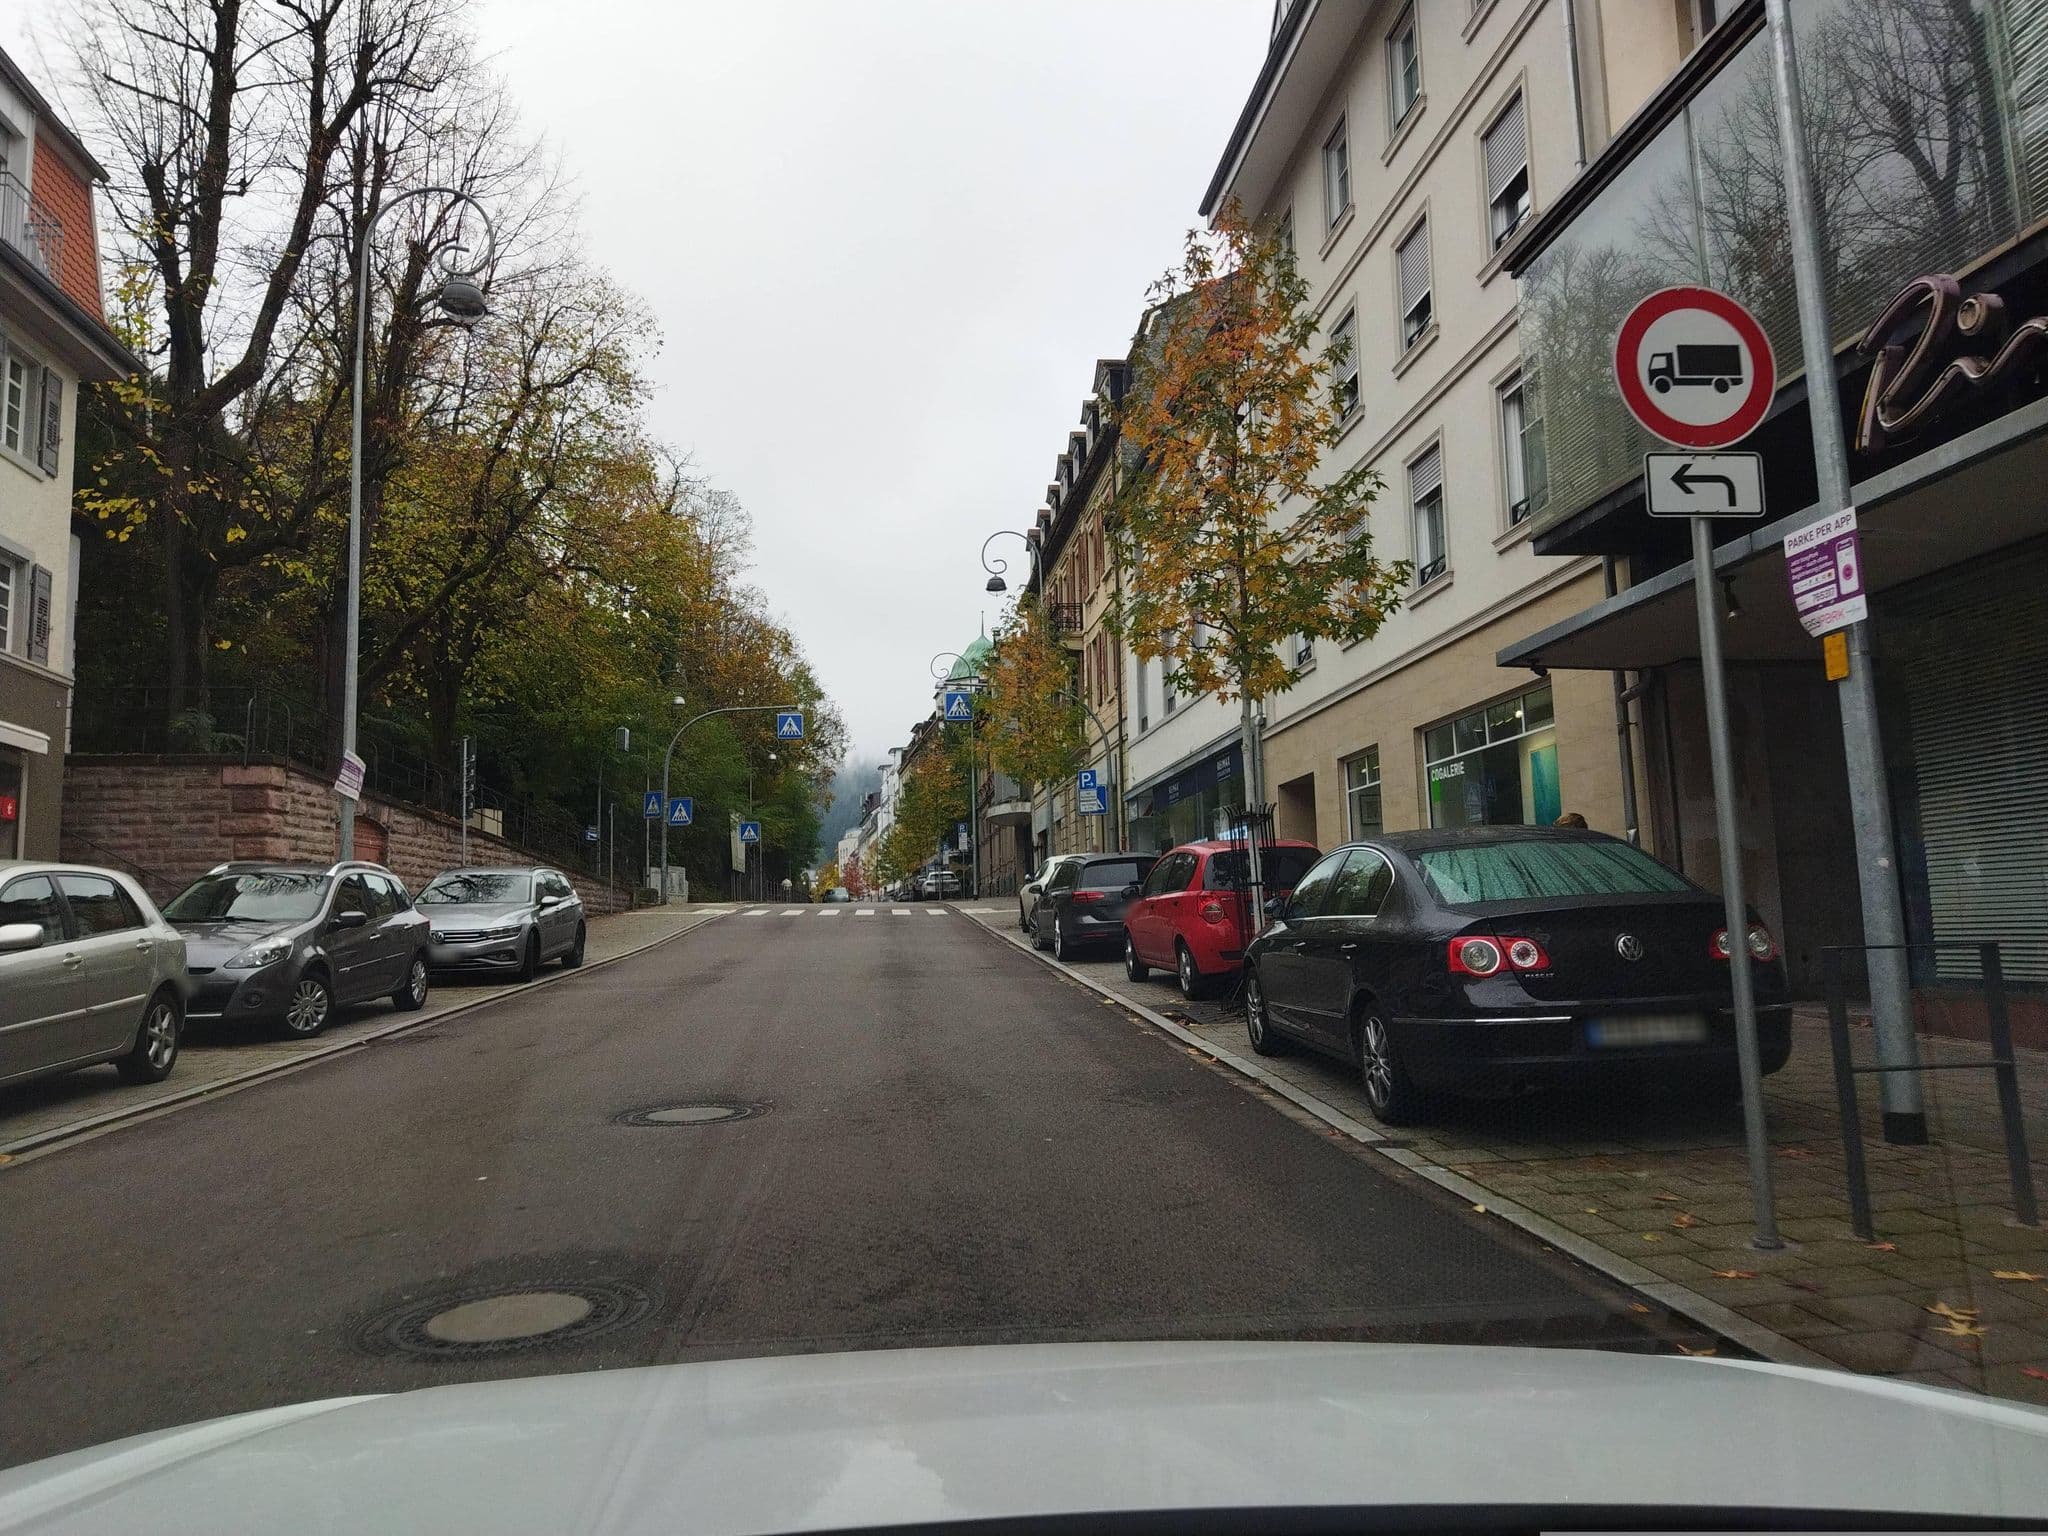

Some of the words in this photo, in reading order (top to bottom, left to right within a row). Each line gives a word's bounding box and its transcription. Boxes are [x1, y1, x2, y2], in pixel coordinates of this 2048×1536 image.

[1788, 530, 1814, 551] PARKE
[1815, 522, 1832, 539] PER
[1834, 514, 1852, 530] APP
[1081, 772, 1091, 788] P
[1431, 761, 1465, 782] COGALERIE
